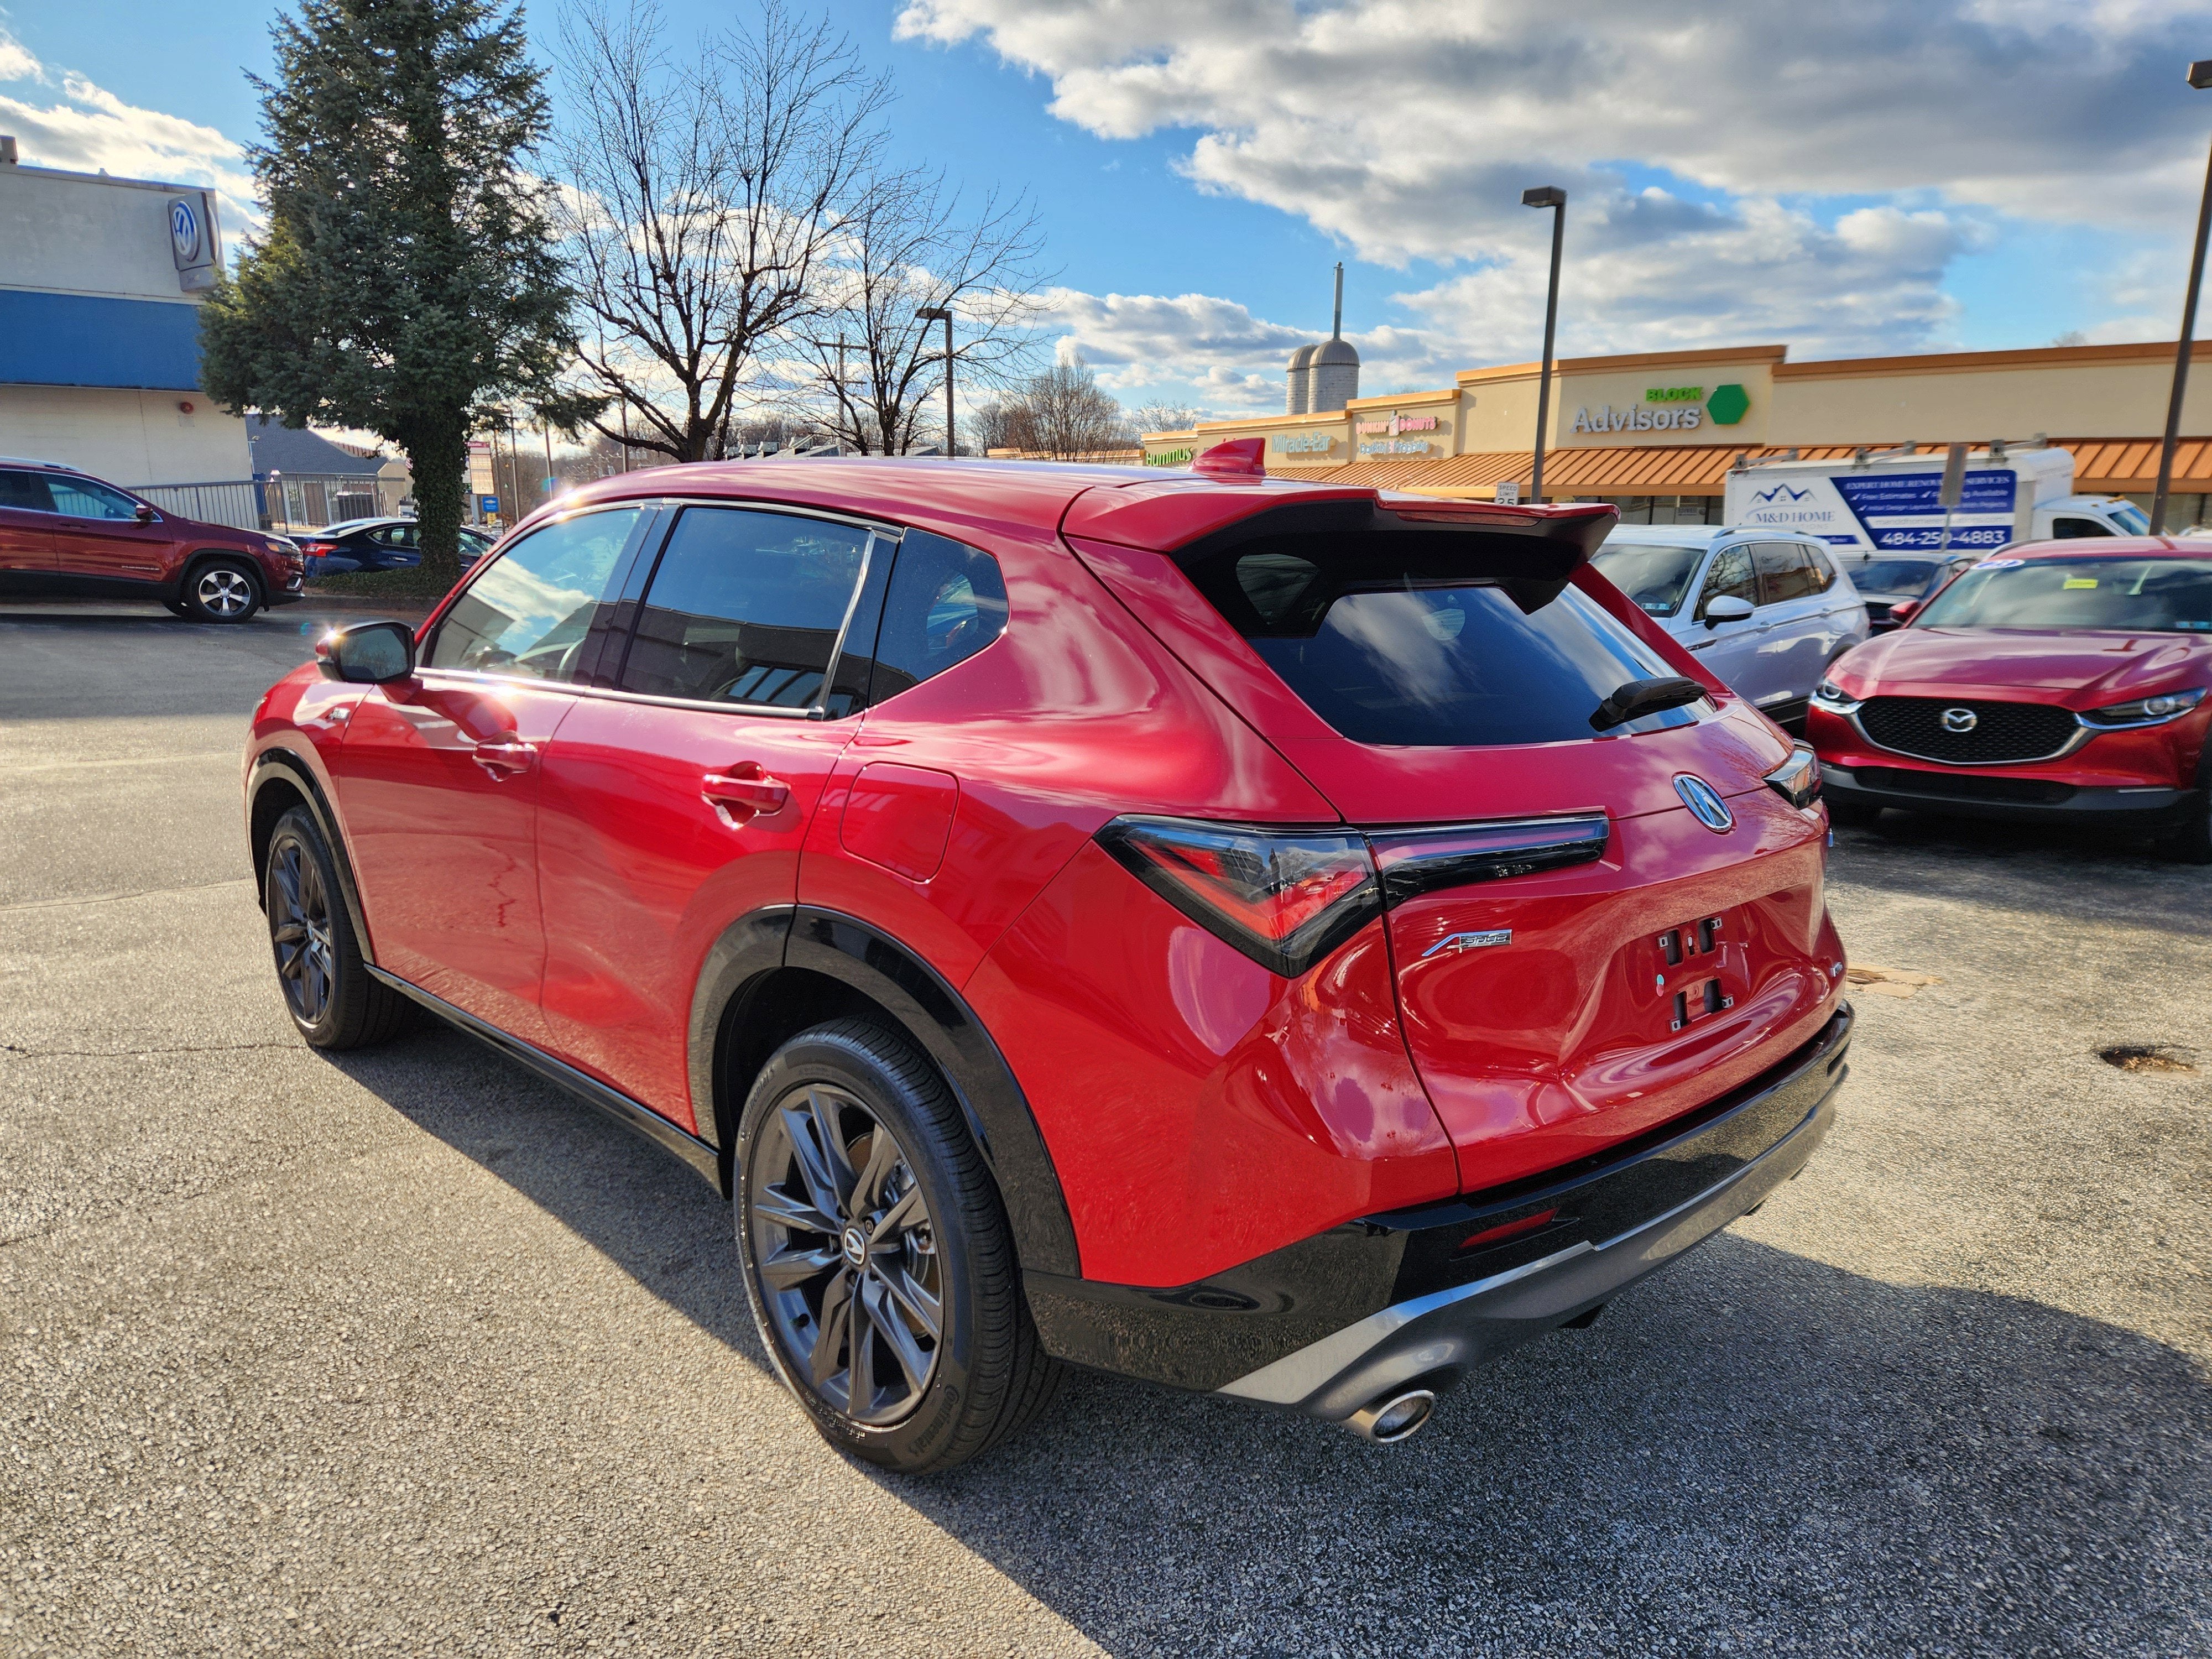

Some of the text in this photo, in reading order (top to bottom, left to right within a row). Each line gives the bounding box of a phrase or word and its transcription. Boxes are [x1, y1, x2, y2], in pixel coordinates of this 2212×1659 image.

[1646, 387, 1702, 401] BLOCK
[1399, 416, 1437, 432] DONUTS
[1570, 404, 1701, 433] Advisors
[1272, 431, 1331, 453] Miracle-Ear
[1880, 480, 1905, 488] HOME
[1755, 511, 1836, 524] M&D HOME
[1880, 530, 2005, 545] 484-250-4883
